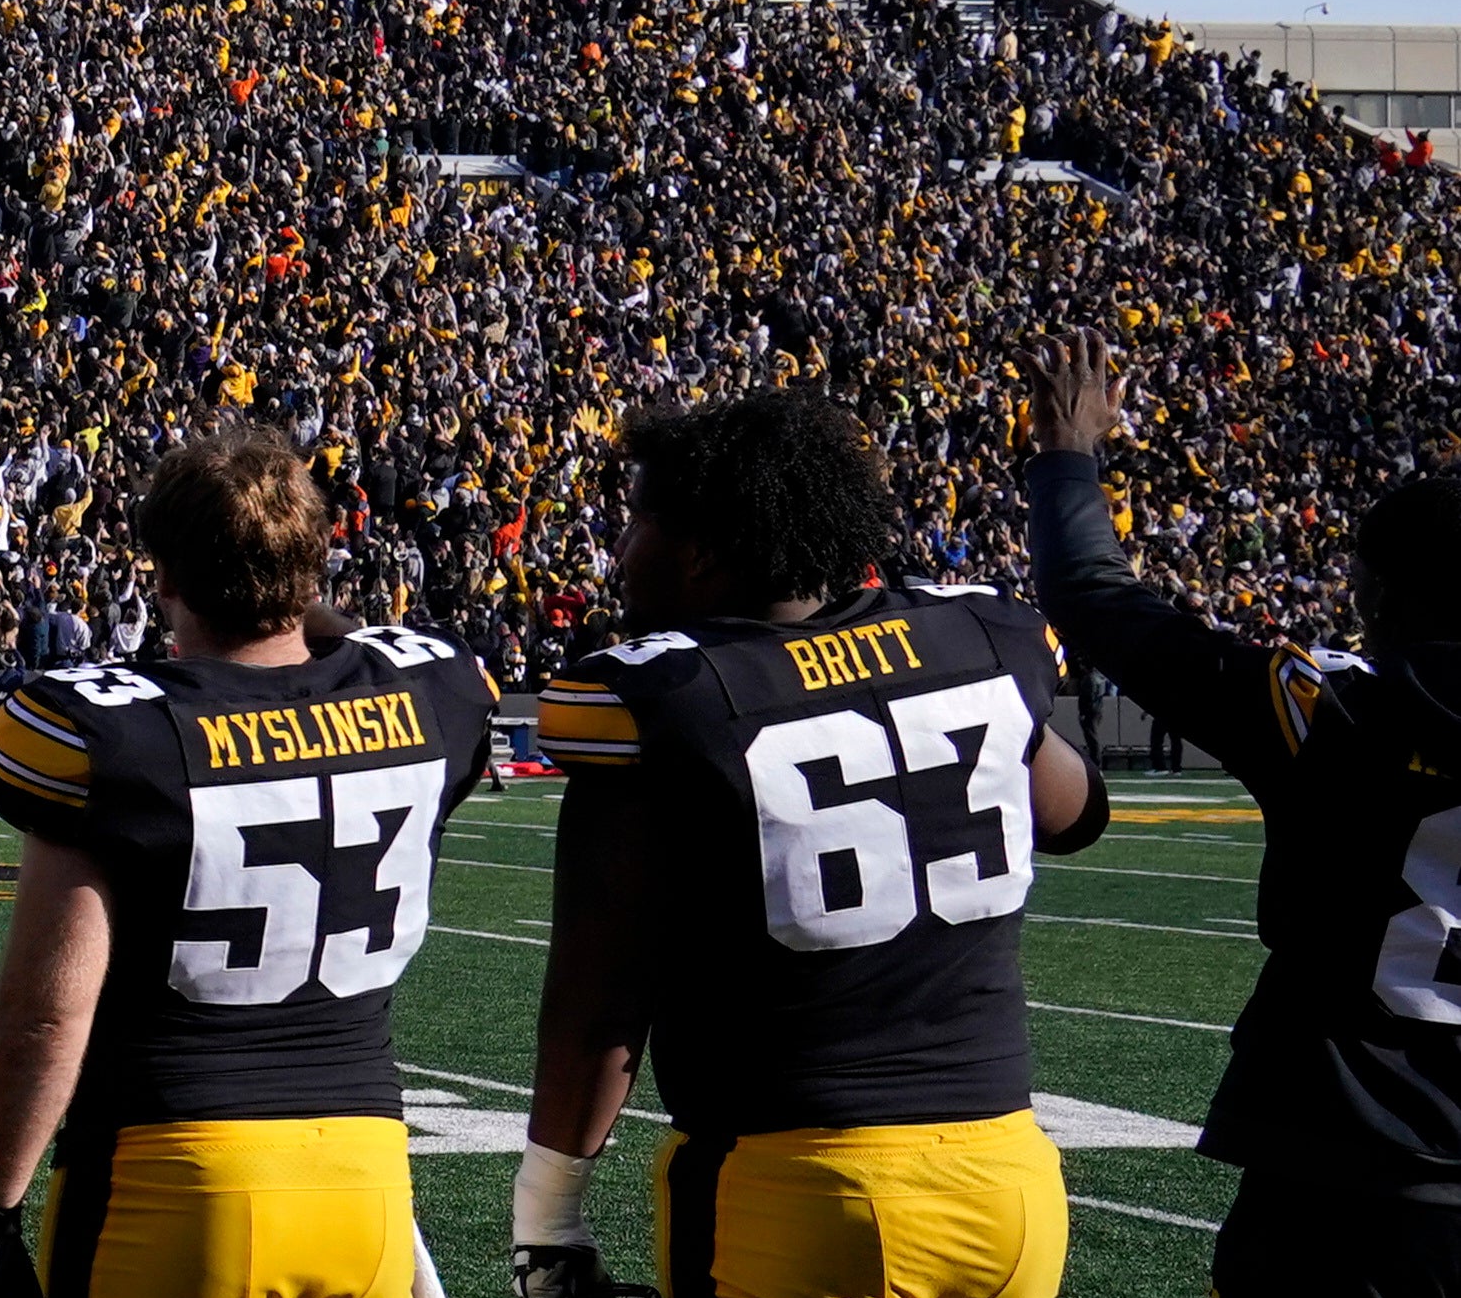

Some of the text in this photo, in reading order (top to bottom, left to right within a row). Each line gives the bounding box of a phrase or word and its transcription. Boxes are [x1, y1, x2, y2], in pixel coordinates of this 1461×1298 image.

[197, 692, 426, 769] MYSLINSKI
[784, 618, 922, 691] BRITT
[167, 758, 447, 1005] 53
[745, 674, 1035, 952] 63
